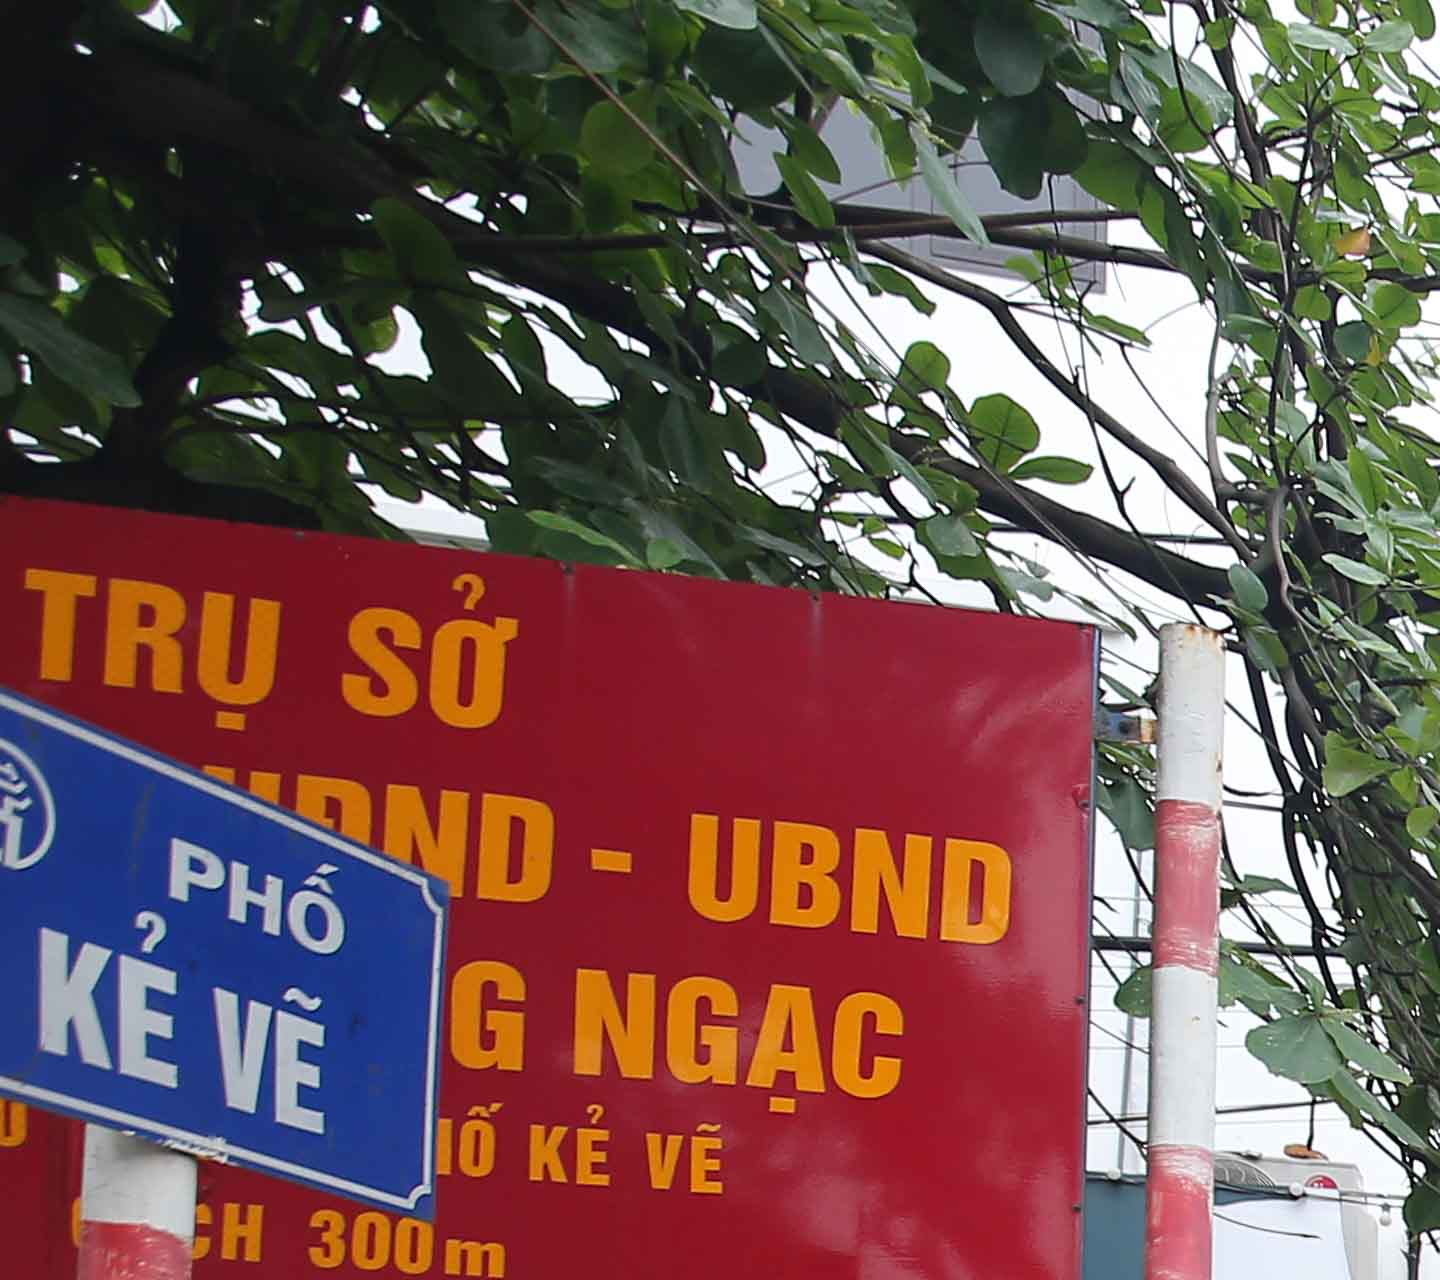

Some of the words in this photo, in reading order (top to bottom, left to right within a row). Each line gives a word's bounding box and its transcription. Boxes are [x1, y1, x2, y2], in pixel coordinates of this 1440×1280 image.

[24, 568, 284, 734] TRỤ
[341, 572, 522, 734] SỞ
[167, 836, 346, 957] PHỐ
[686, 812, 1014, 946] UBND
[37, 908, 180, 1090] KẺ
[213, 986, 326, 1137] VẼ
[571, 967, 907, 1115] NGẠC
[528, 1101, 613, 1192] KẺ
[646, 1121, 728, 1197] VẼ
